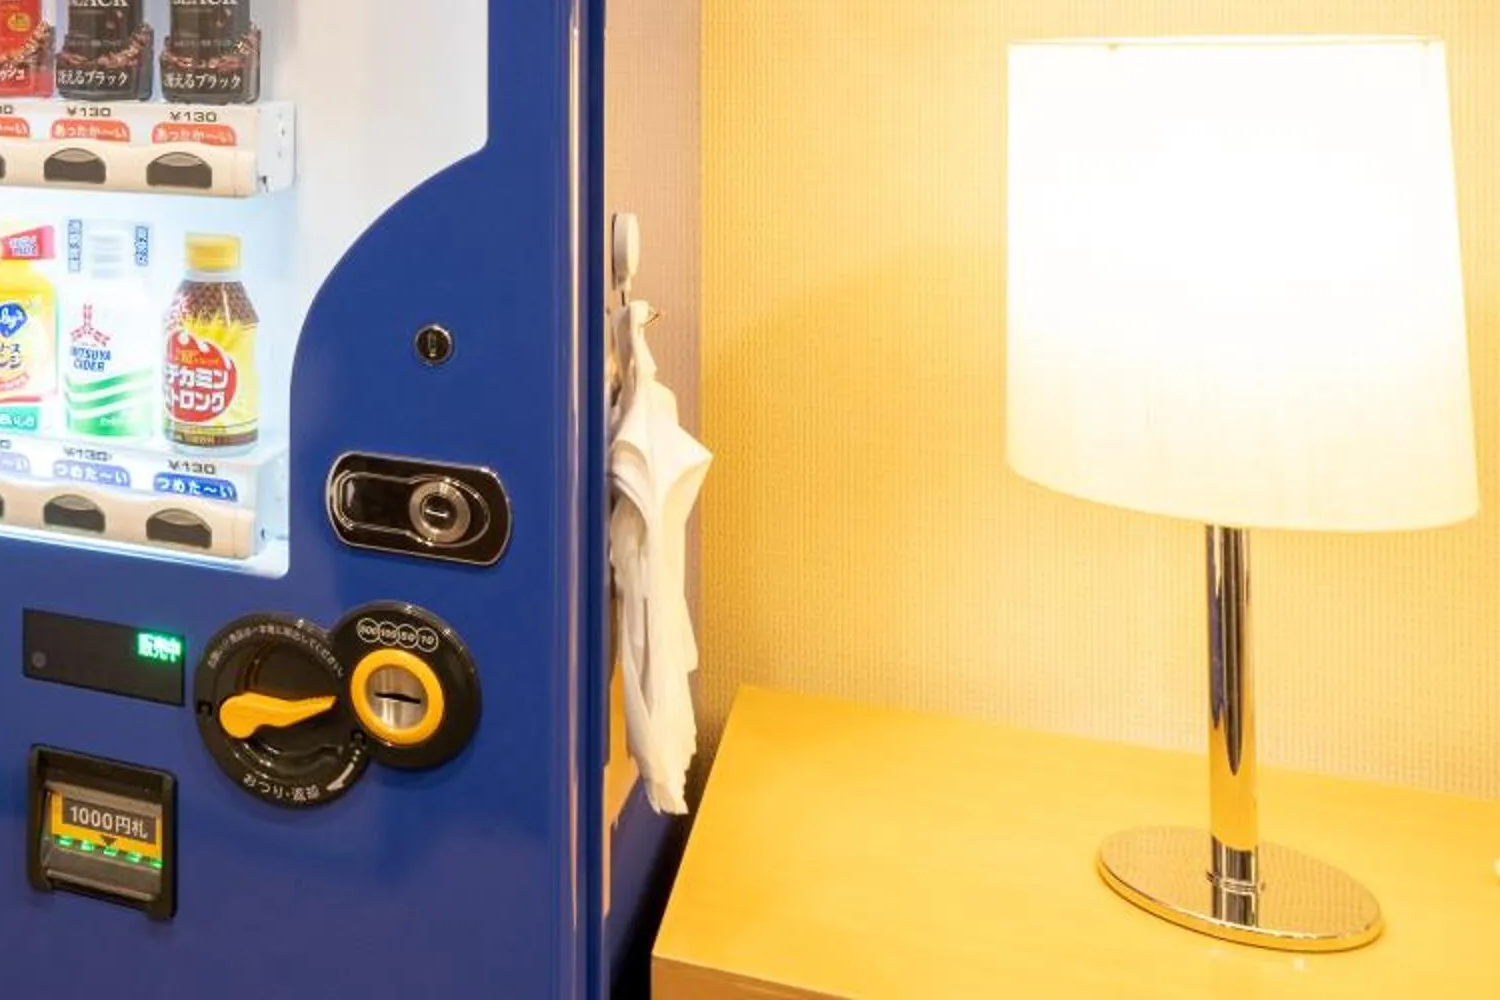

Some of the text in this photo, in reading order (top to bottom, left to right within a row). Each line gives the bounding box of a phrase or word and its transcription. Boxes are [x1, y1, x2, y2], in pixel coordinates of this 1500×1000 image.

[67, 107, 112, 118] ¥130
[169, 111, 218, 122] ¥130
[168, 460, 216, 474] ¥130
[69, 804, 148, 839] 1000円札
